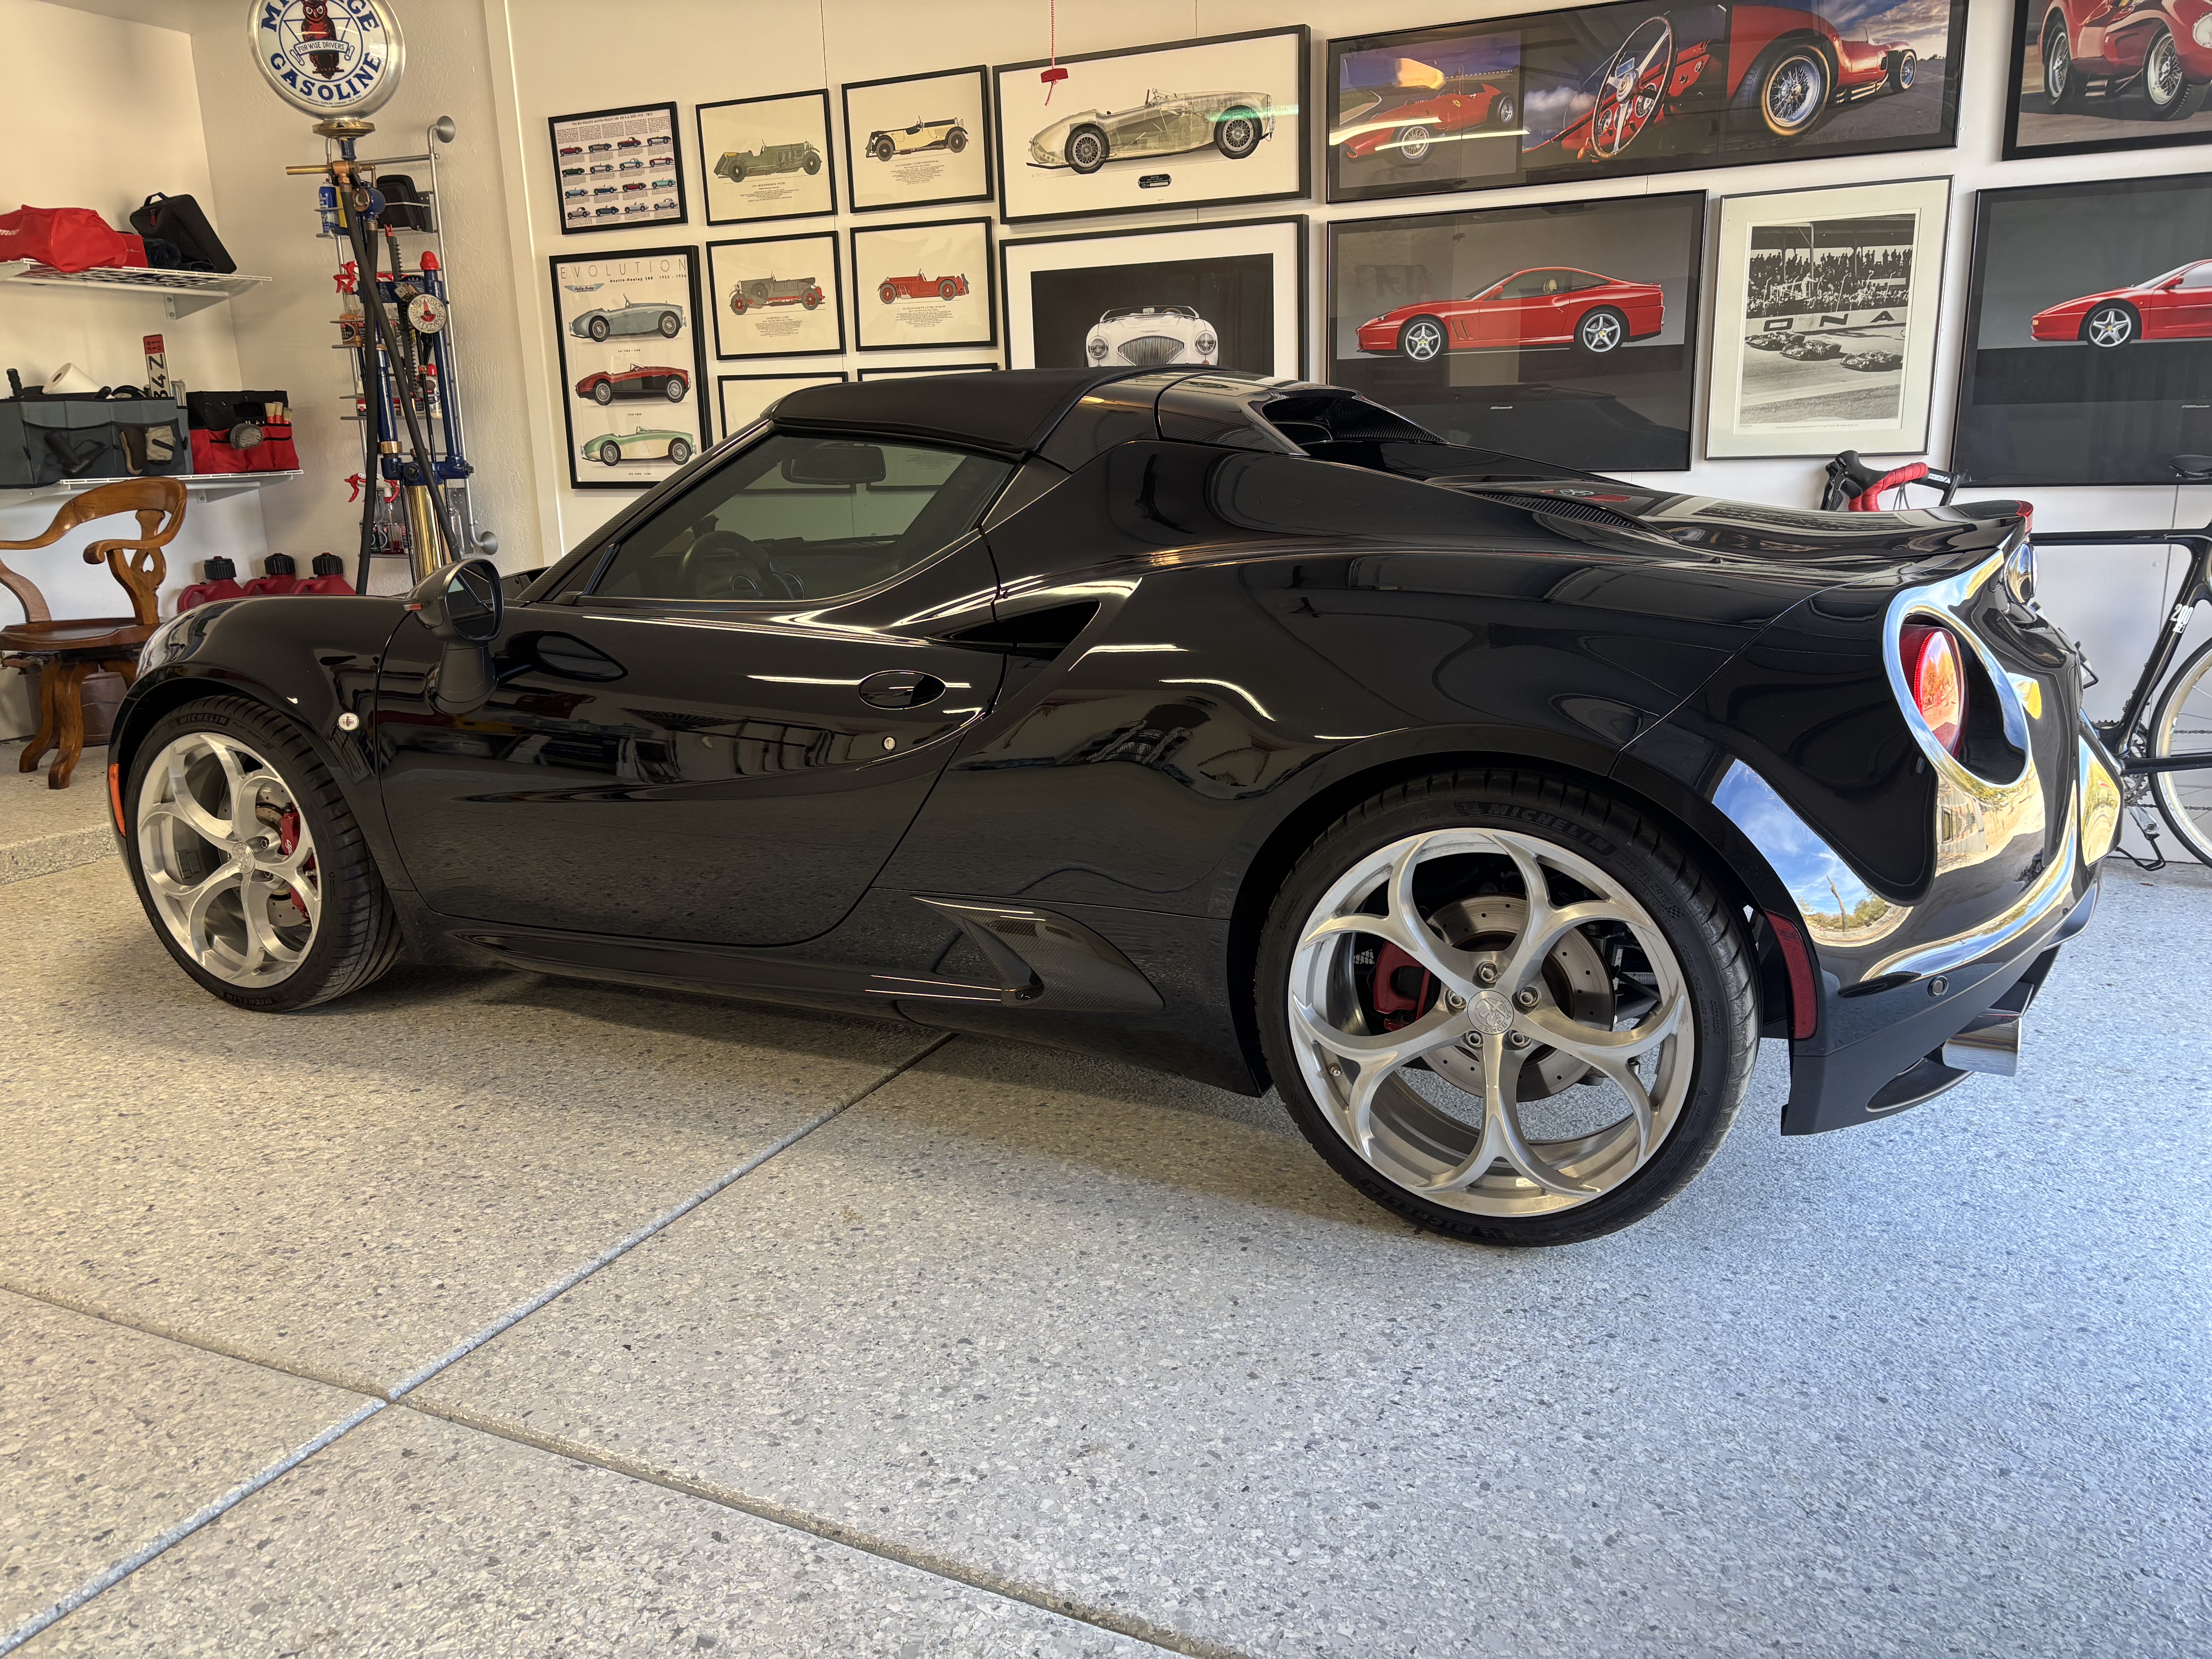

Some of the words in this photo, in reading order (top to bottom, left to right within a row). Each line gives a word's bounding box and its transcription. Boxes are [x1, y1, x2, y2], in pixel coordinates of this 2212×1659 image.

[270, 53, 382, 101] GASOLINE
[560, 258, 686, 279] EVOLUTION
[2170, 603, 2194, 625] 200
[180, 714, 227, 724] MICHELIN
[1487, 803, 1611, 852] MICHELIN
[1620, 852, 1652, 886] 235/35
[1649, 882, 1671, 905] ZR19
[226, 993, 272, 1006] MICHELIN
[1709, 999, 1723, 1036] OUTSIDE
[1360, 1180, 1476, 1237] MICHELIN
